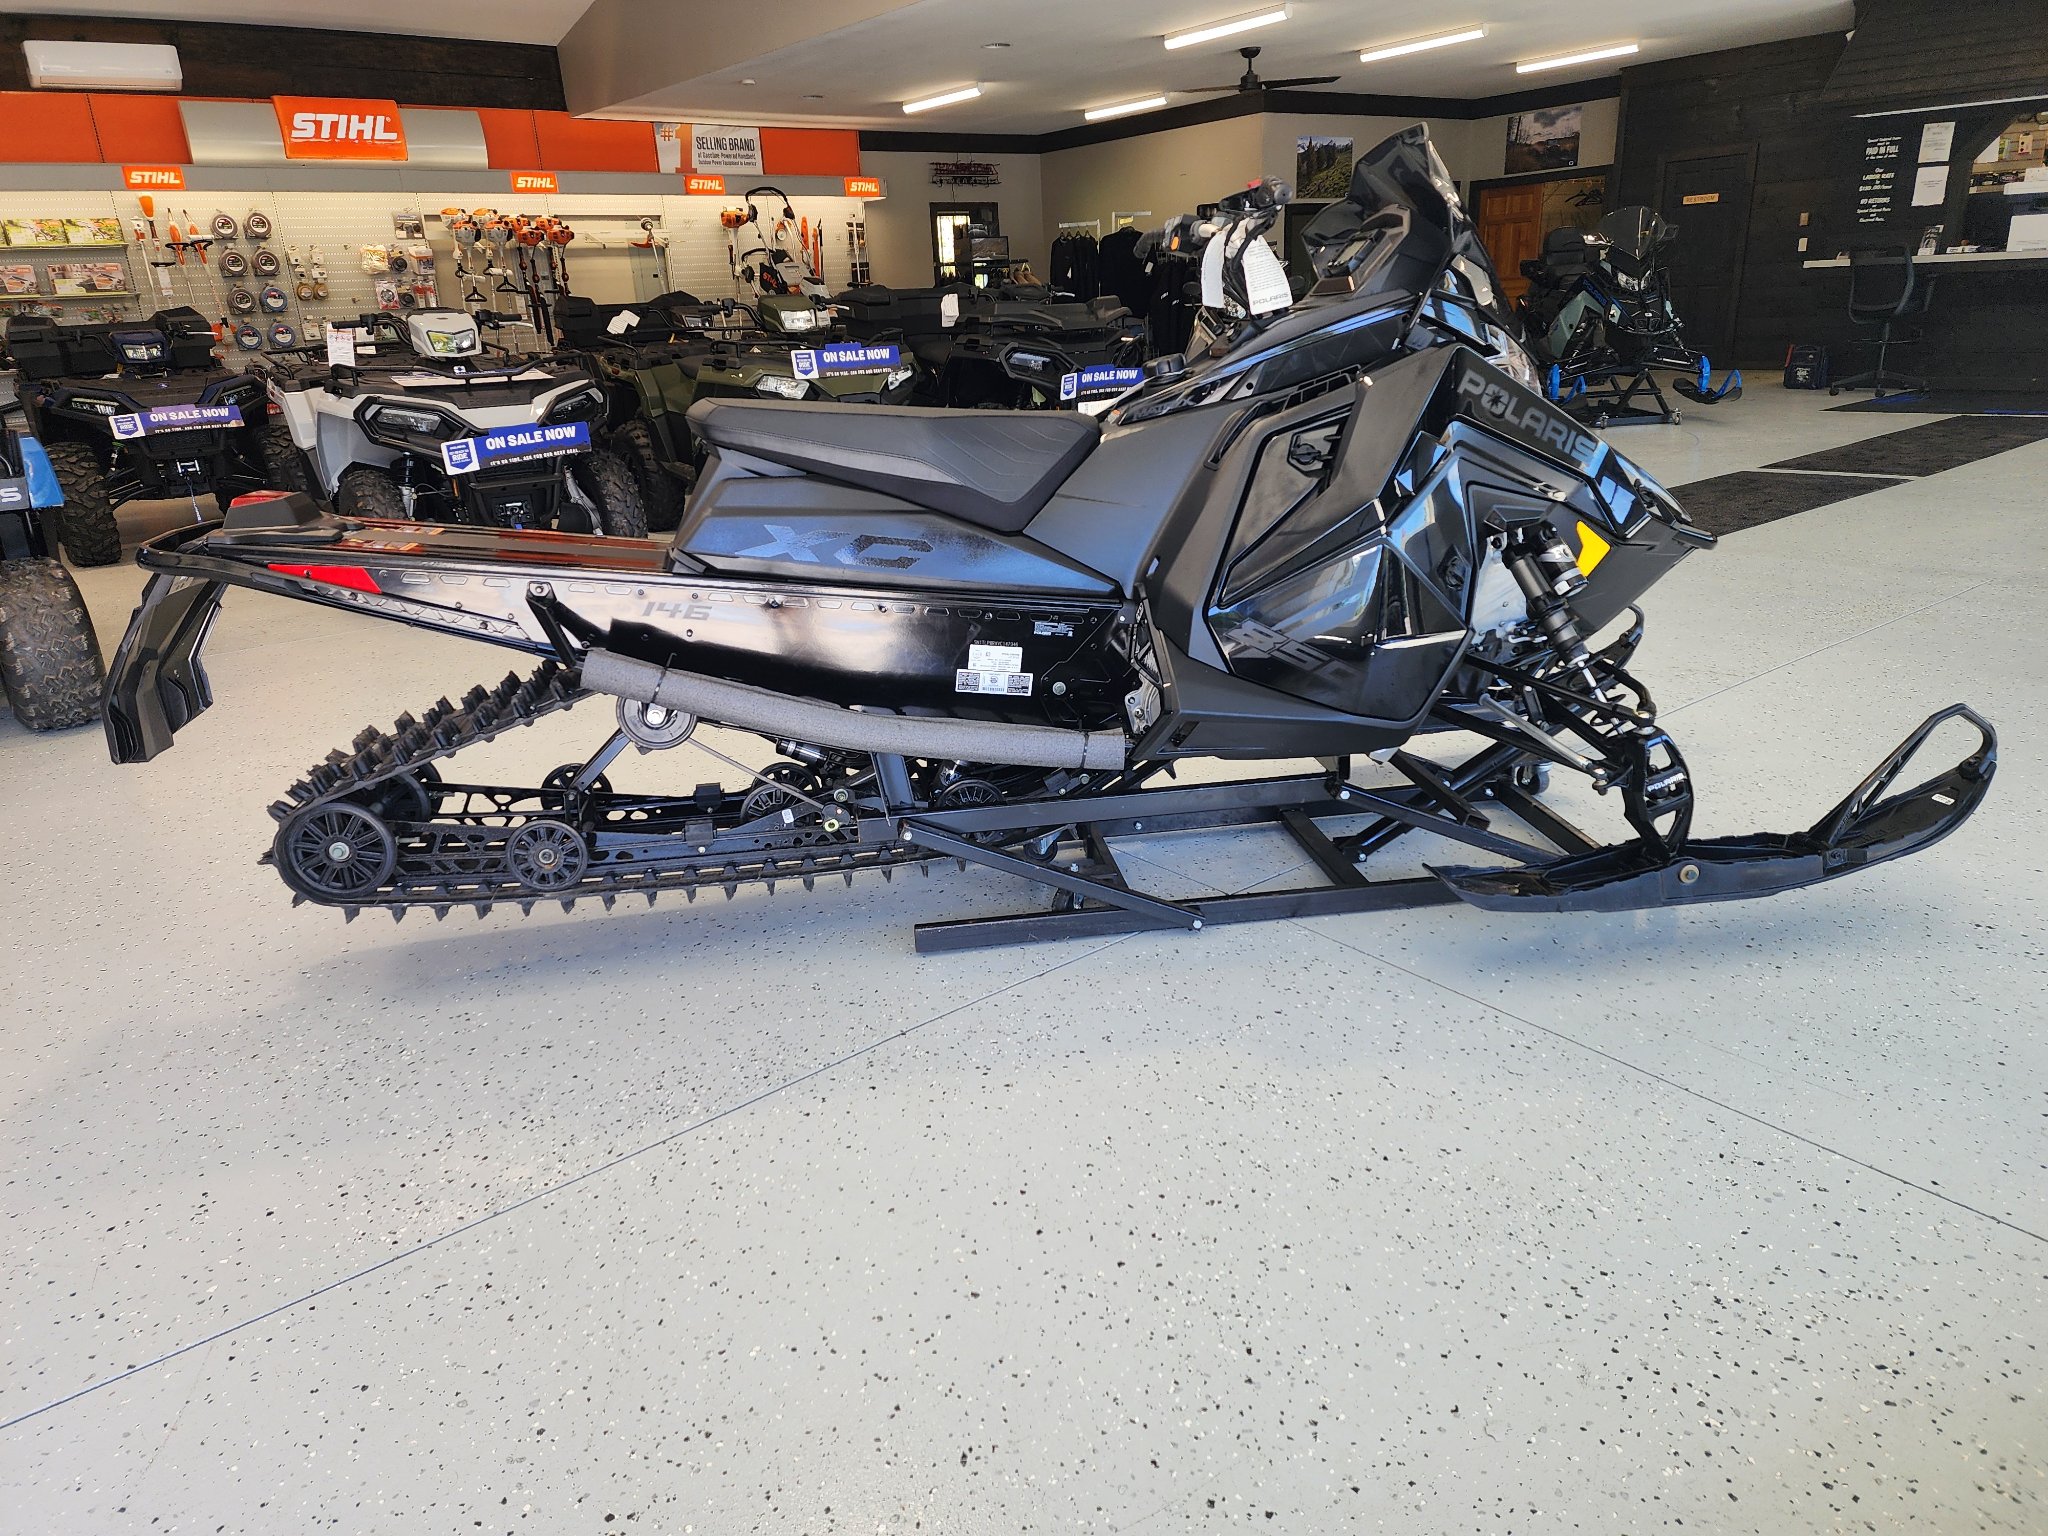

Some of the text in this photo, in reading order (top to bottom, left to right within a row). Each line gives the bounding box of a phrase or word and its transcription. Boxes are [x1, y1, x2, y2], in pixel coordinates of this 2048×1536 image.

[291, 112, 398, 140] STIHL
[695, 136, 755, 152] SELLING BRAND
[1865, 145, 1899, 155] PAID IN FULL
[130, 171, 181, 184] STIHL
[516, 176, 555, 188] STIHL
[689, 178, 723, 190] STIHL
[850, 181, 878, 192] STIHL
[1252, 292, 1289, 306] POLARIS
[823, 348, 890, 363] ON SALE NOW
[1081, 369, 1138, 383] ON SALE NOW
[149, 407, 229, 422] ON SALE NOW
[1456, 368, 1599, 464] POLARIS
[485, 426, 576, 450] ON SALE NOW
[734, 524, 935, 570] XC
[642, 601, 713, 621] 146
